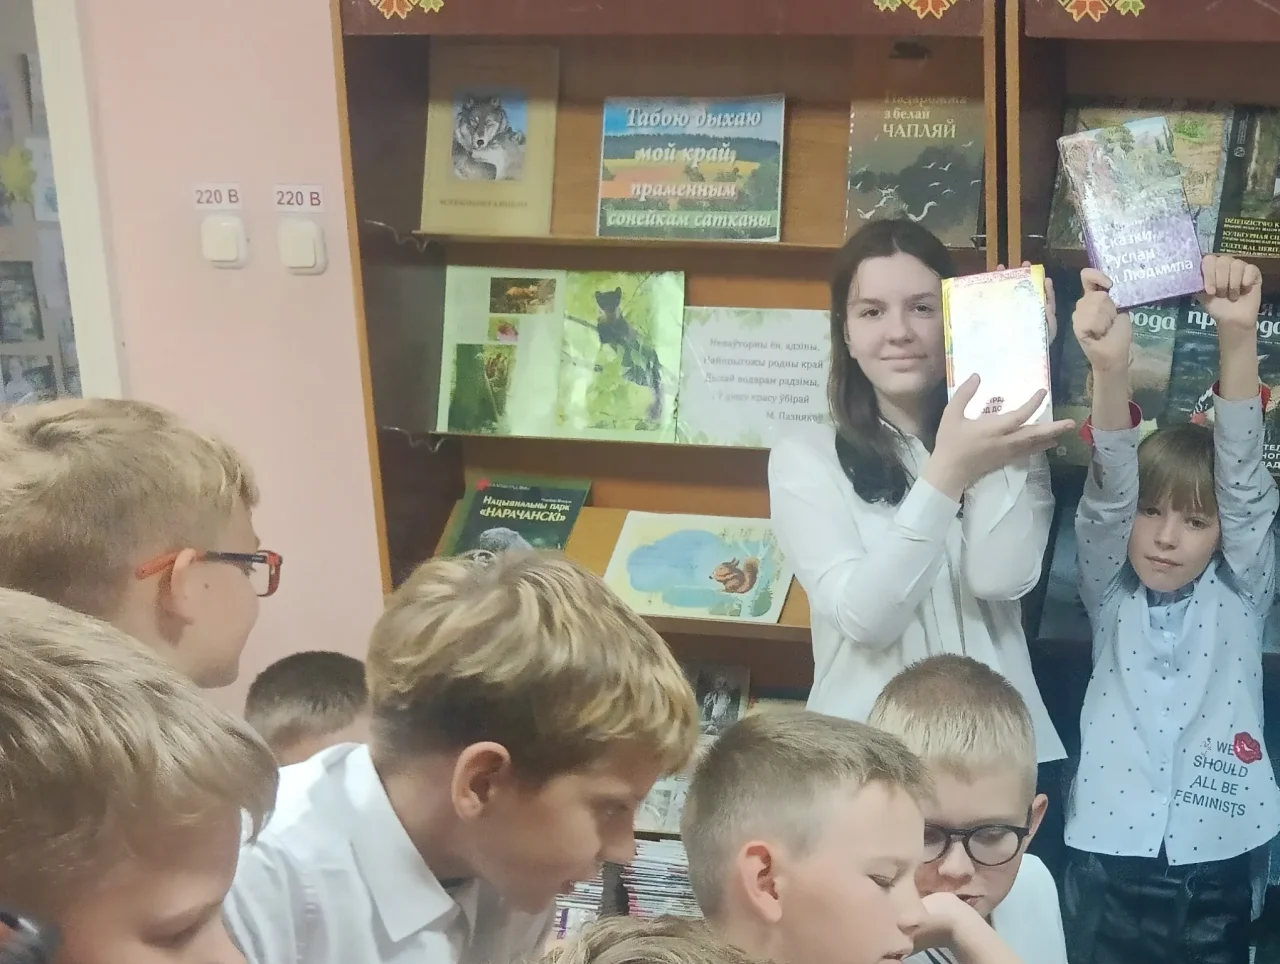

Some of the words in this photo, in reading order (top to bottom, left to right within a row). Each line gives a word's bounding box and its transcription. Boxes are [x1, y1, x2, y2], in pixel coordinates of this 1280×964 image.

[626, 107, 690, 128] Табою
[883, 119, 956, 138] ЧАПЛЯЙ
[635, 142, 677, 162] мой
[195, 189, 223, 204] 220
[277, 191, 304, 206] 220
[694, 210, 771, 227] сатканы
[1123, 260, 1194, 282] Людмила
[768, 359, 799, 369] родны
[801, 360, 823, 371] край
[1216, 741, 1234, 756] WE
[1193, 755, 1248, 777] SHOULD
[1192, 775, 1217, 790] ALL
[1221, 781, 1238, 795] BE
[1174, 790, 1246, 816] FEMINISTS
